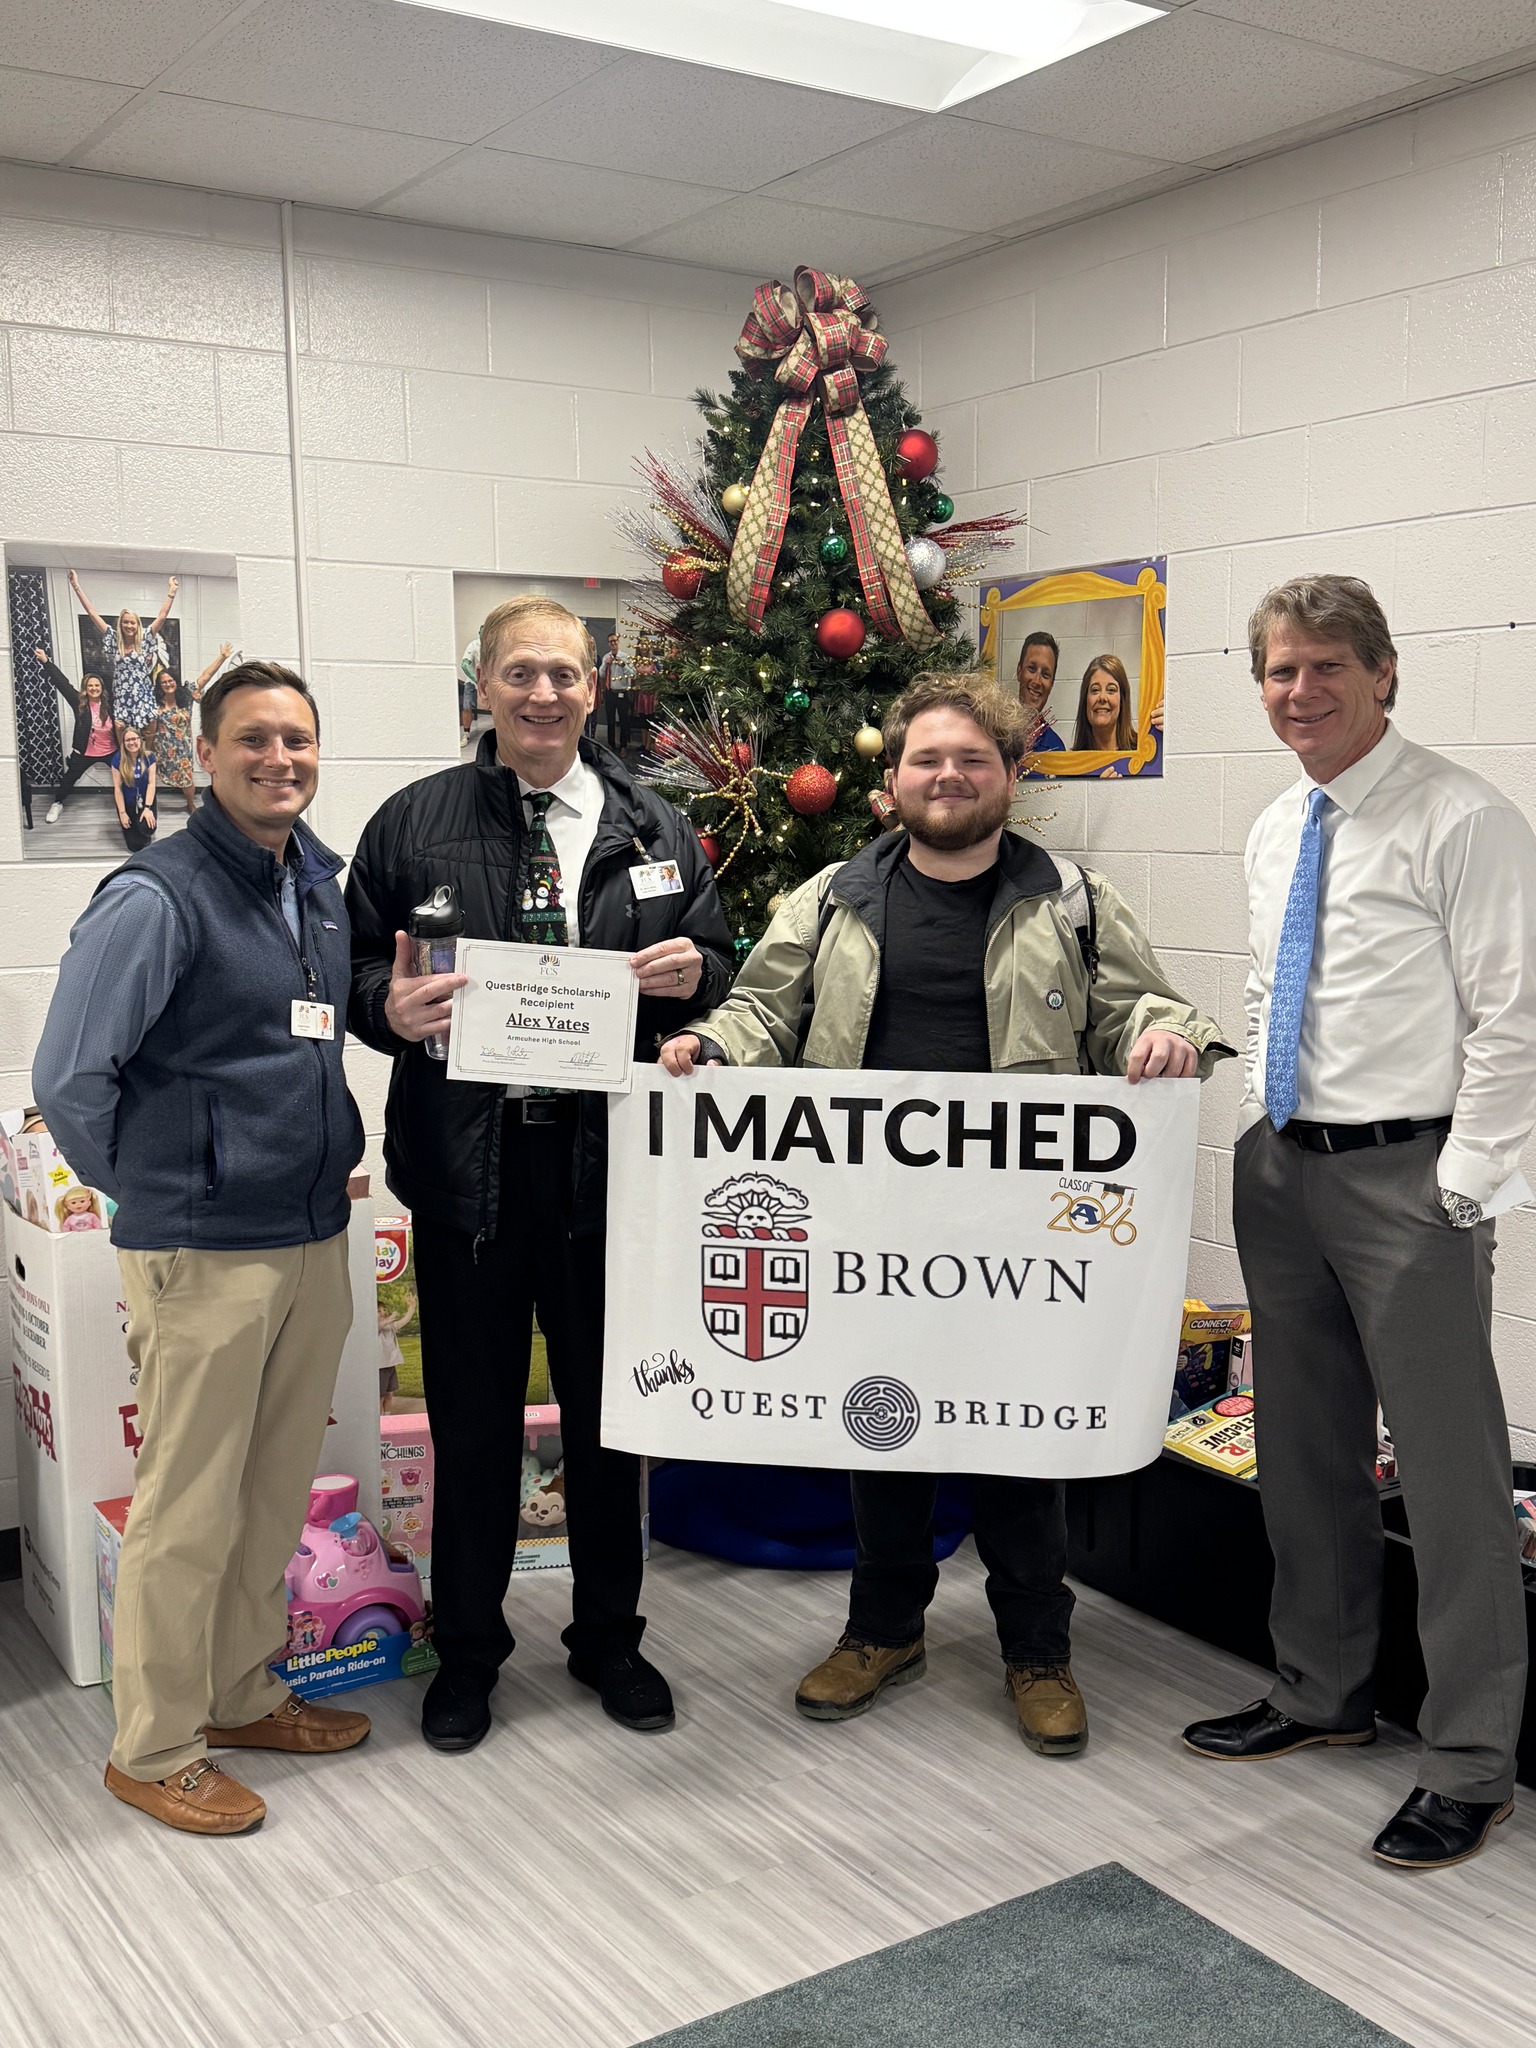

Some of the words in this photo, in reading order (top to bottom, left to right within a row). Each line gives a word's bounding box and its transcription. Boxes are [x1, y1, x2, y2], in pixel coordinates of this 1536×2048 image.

[540, 966, 559, 976] FCS
[485, 980, 549, 995] QuestBridge
[551, 985, 611, 1000] Scholarship
[520, 997, 575, 1011] Receipient
[506, 1012, 541, 1028] Alex
[546, 1015, 590, 1032] Yates
[541, 1037, 557, 1045] High
[558, 1038, 581, 1046] School
[648, 1090, 665, 1157] I
[693, 1091, 1138, 1173] MATCHED
[1058, 1176, 1082, 1192] CLASS
[1082, 1181, 1094, 1193] OF
[1046, 1191, 1138, 1247] 2026
[376, 1245, 397, 1258] lay
[831, 1250, 1093, 1304] BROWN
[1190, 1318, 1234, 1330] CONNECT
[628, 1349, 695, 1397] thanks
[691, 1387, 827, 1420] QUEST
[934, 1399, 1107, 1430] BRIDGE
[283, 1675, 308, 1689] usic
[309, 1667, 346, 1683] Parade
[347, 1655, 386, 1673] Ride-on
